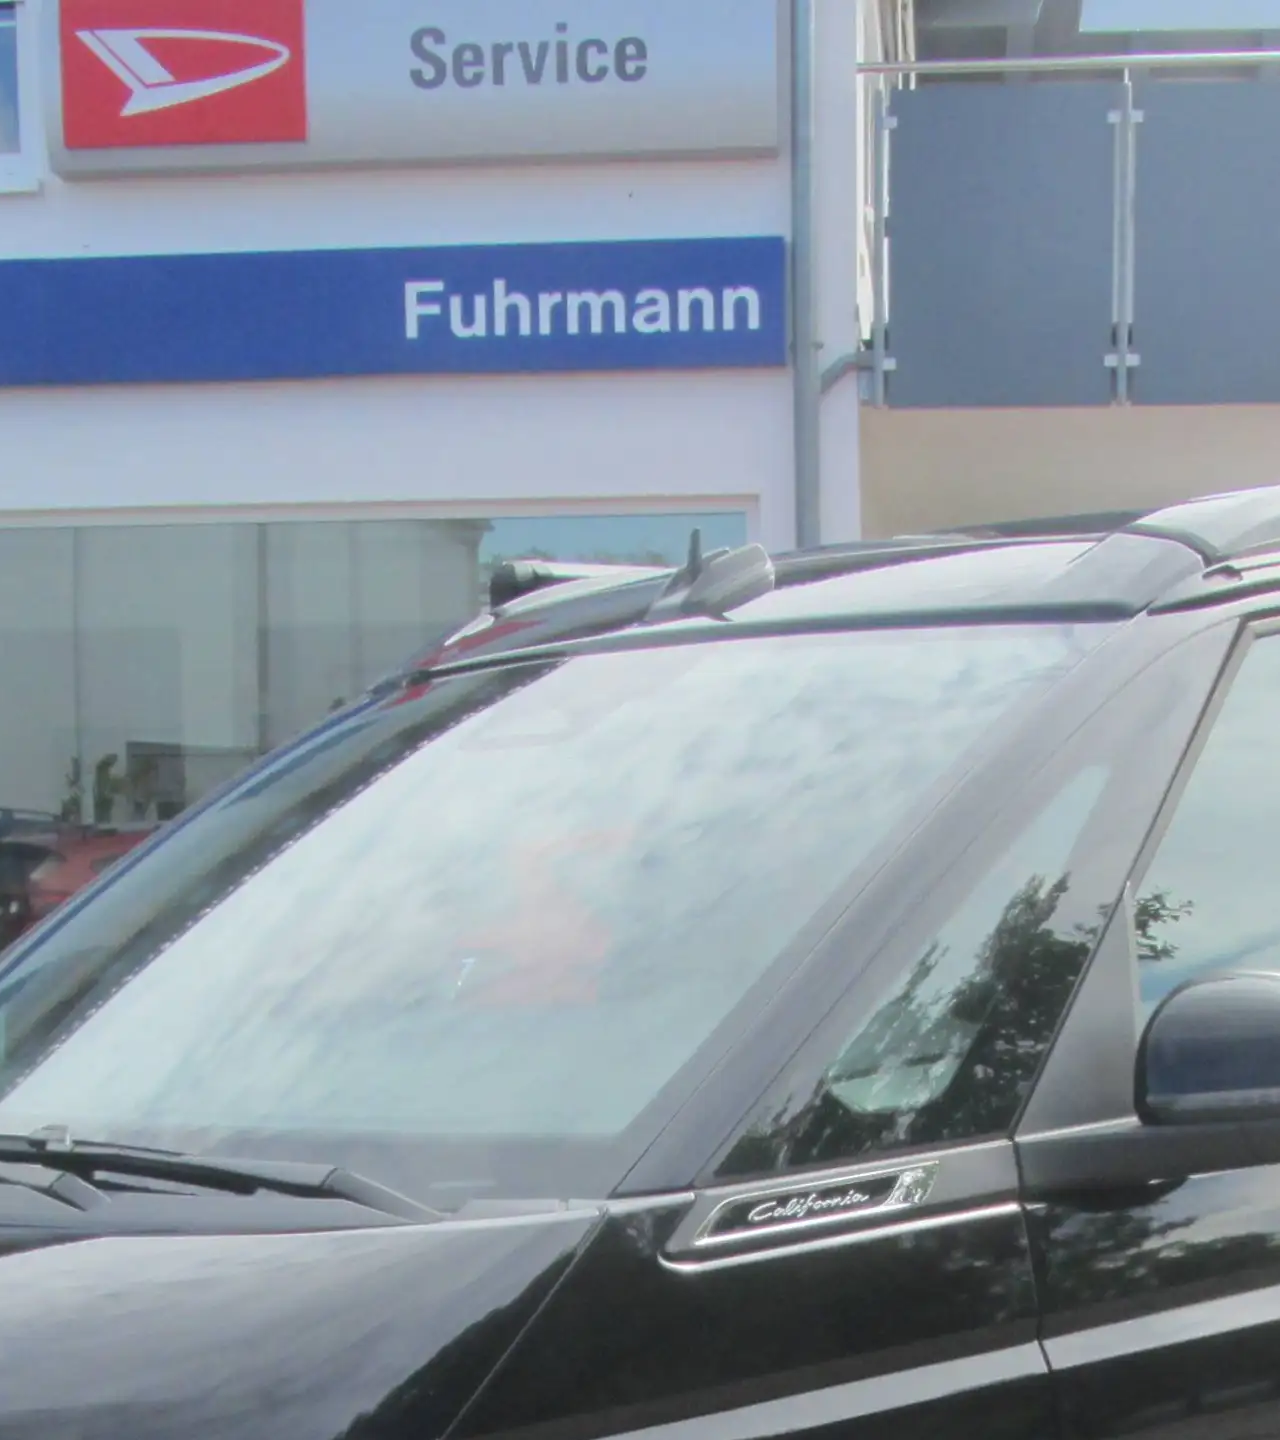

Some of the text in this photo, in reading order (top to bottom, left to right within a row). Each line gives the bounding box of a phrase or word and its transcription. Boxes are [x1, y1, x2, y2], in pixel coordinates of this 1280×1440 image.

[409, 21, 649, 90] Service
[404, 278, 761, 339] Fuhrmann
[747, 1188, 870, 1222] California
